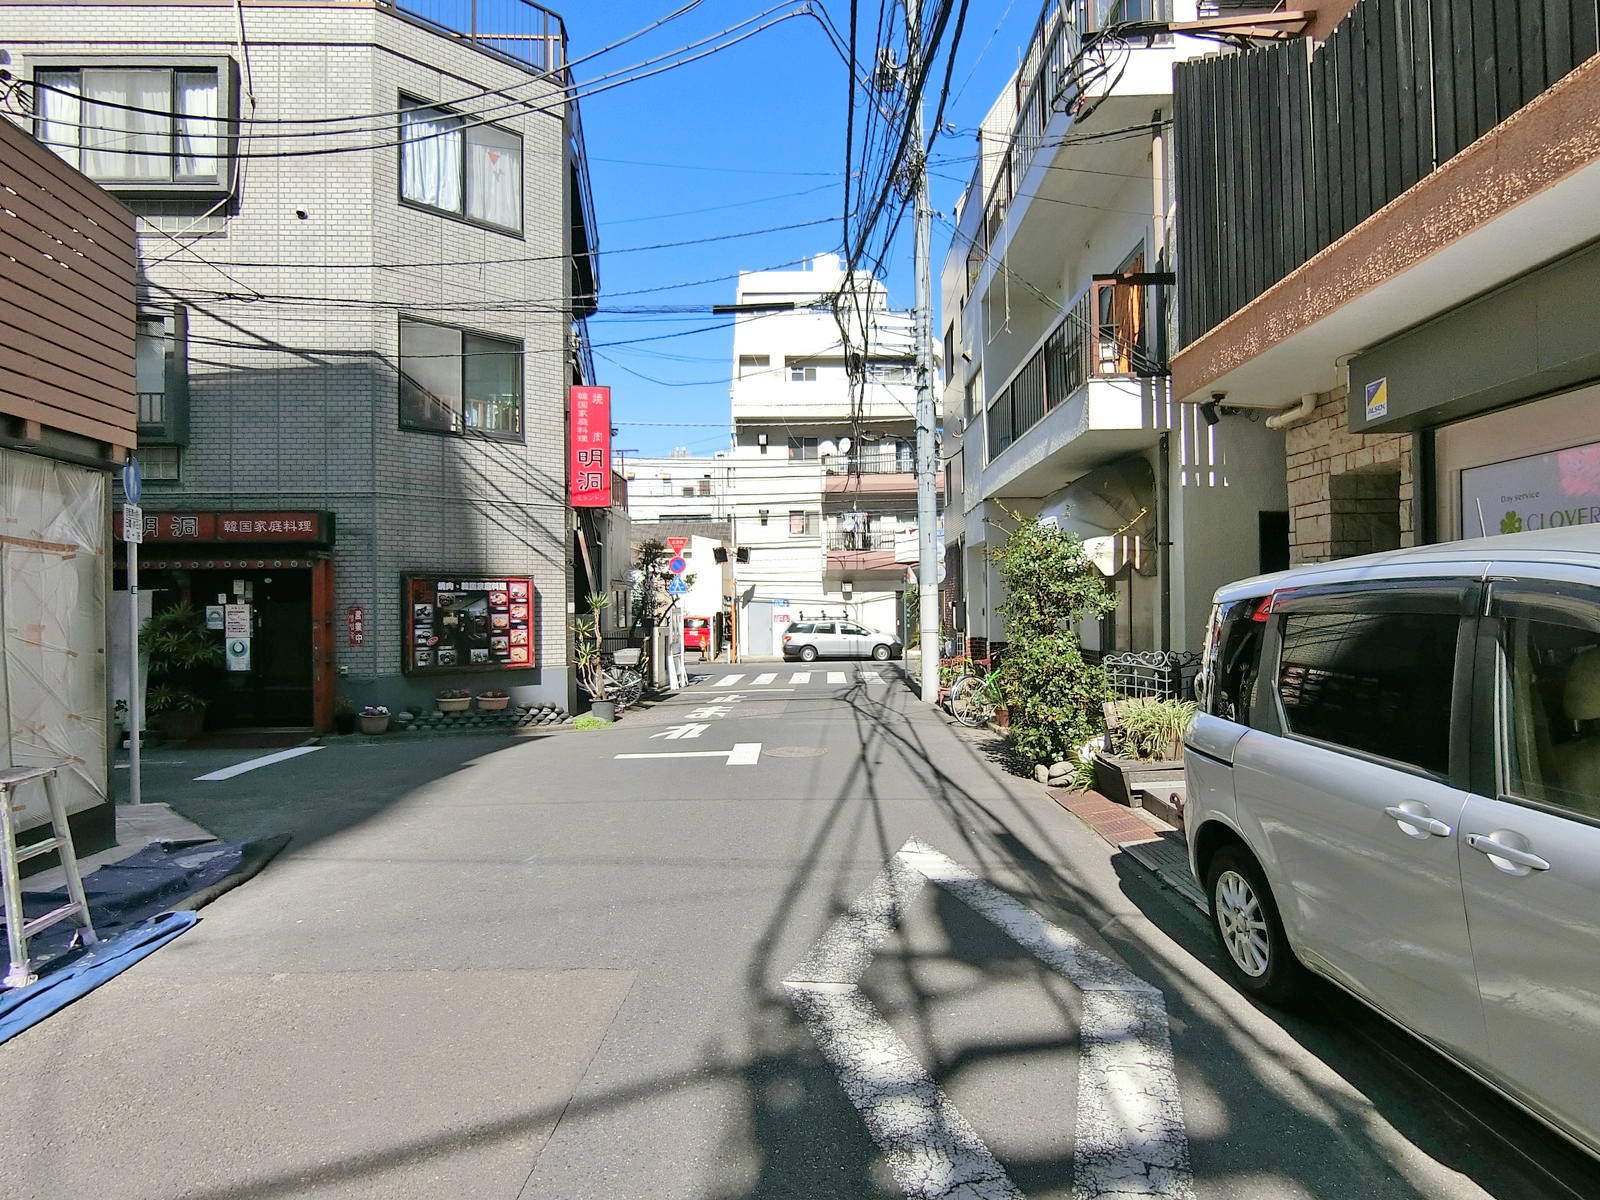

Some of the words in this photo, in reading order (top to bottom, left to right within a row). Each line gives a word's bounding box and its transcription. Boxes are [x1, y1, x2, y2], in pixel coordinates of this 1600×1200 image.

[577, 448, 604, 491] 明洞
[1500, 495, 1513, 503] Day
[1514, 490, 1540, 501] service
[223, 520, 313, 533] 韓国家庭料理
